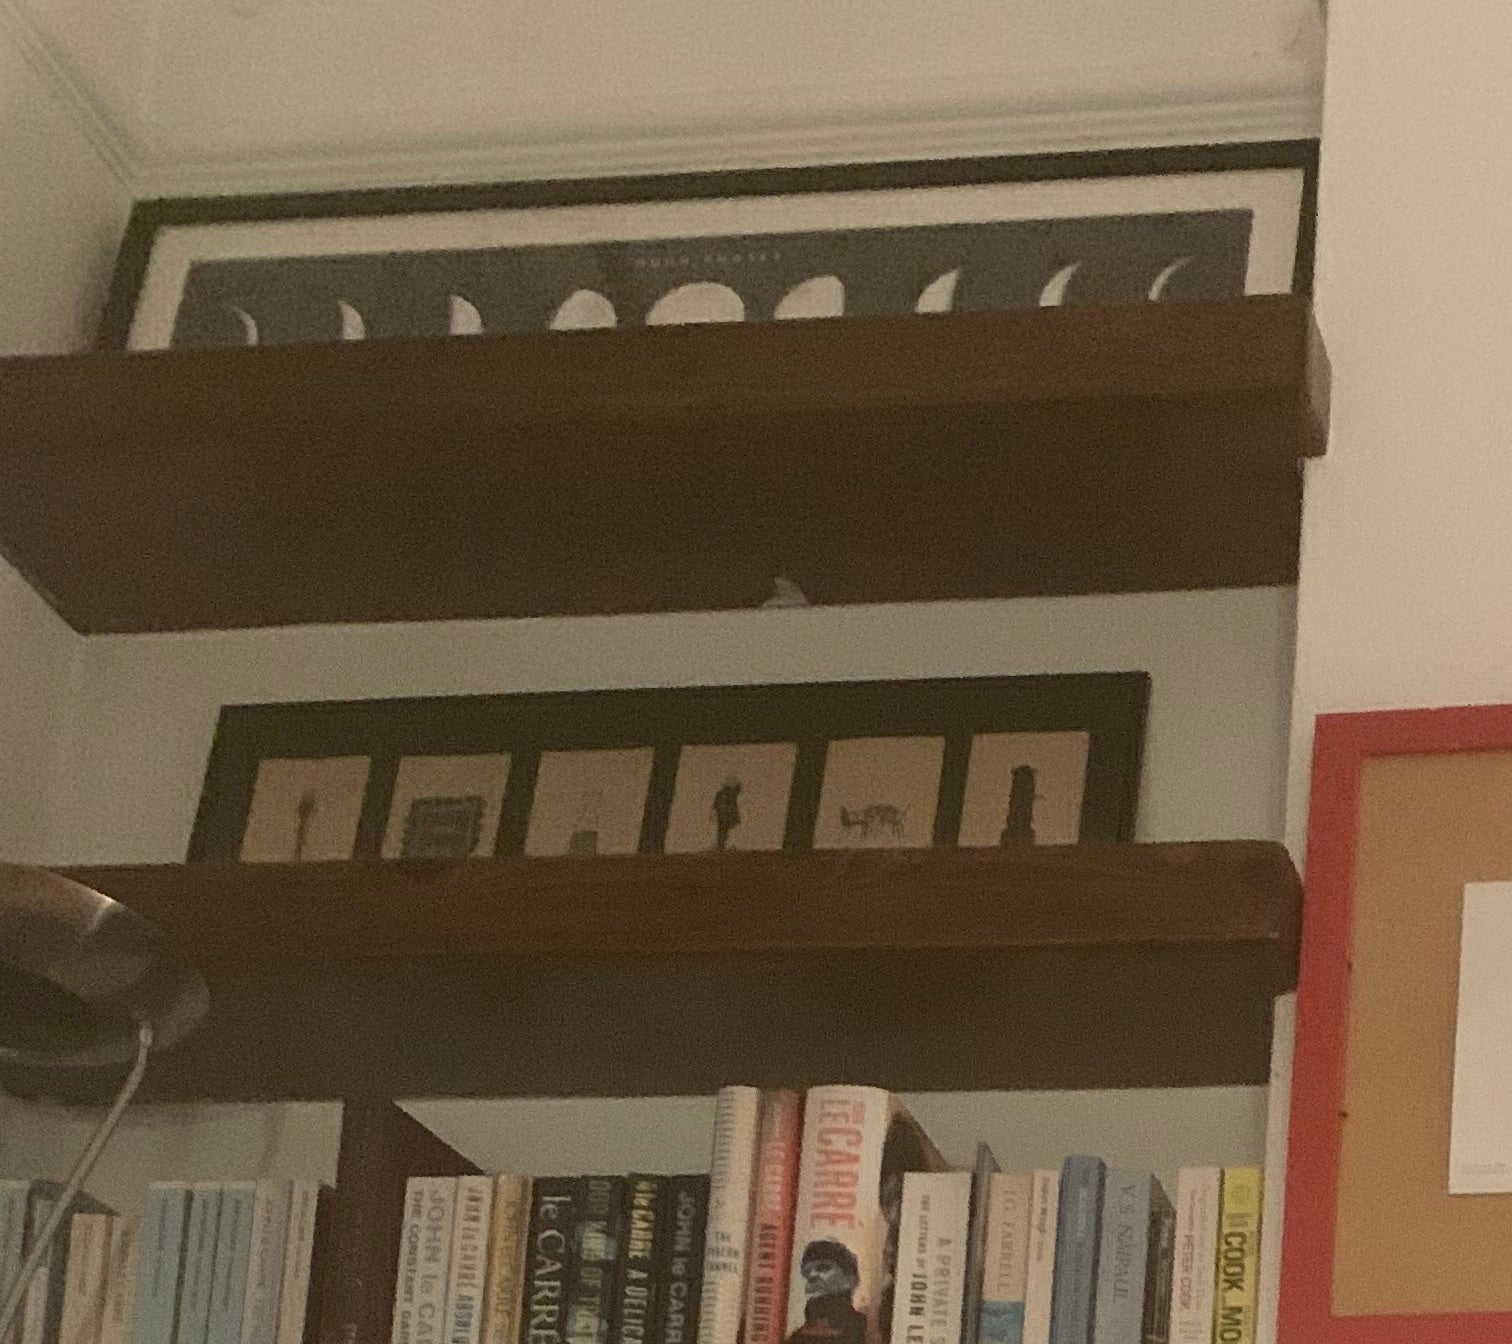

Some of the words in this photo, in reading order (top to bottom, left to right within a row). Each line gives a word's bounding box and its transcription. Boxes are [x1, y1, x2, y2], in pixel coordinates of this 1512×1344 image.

[411, 1189, 425, 1220] THE
[464, 1187, 484, 1223] JOHN
[541, 1195, 572, 1219] le
[587, 1180, 612, 1215] OUR
[424, 1189, 446, 1263] JOHN
[673, 1190, 697, 1252] JOHN
[757, 1223, 778, 1269] AGENT
[936, 1237, 953, 1247] A
[996, 1220, 1018, 1294] FARRELL
[1181, 1234, 1195, 1274] PETER
[1222, 1230, 1247, 1293] COOK
[403, 1223, 422, 1305] CONSTANT
[626, 1268, 649, 1280] A
[671, 1256, 687, 1276] le
[751, 1276, 775, 1342] RUNNING
[908, 1273, 929, 1316] JOHN
[930, 1254, 952, 1328] PRIVATE
[906, 1324, 925, 1344] LE
